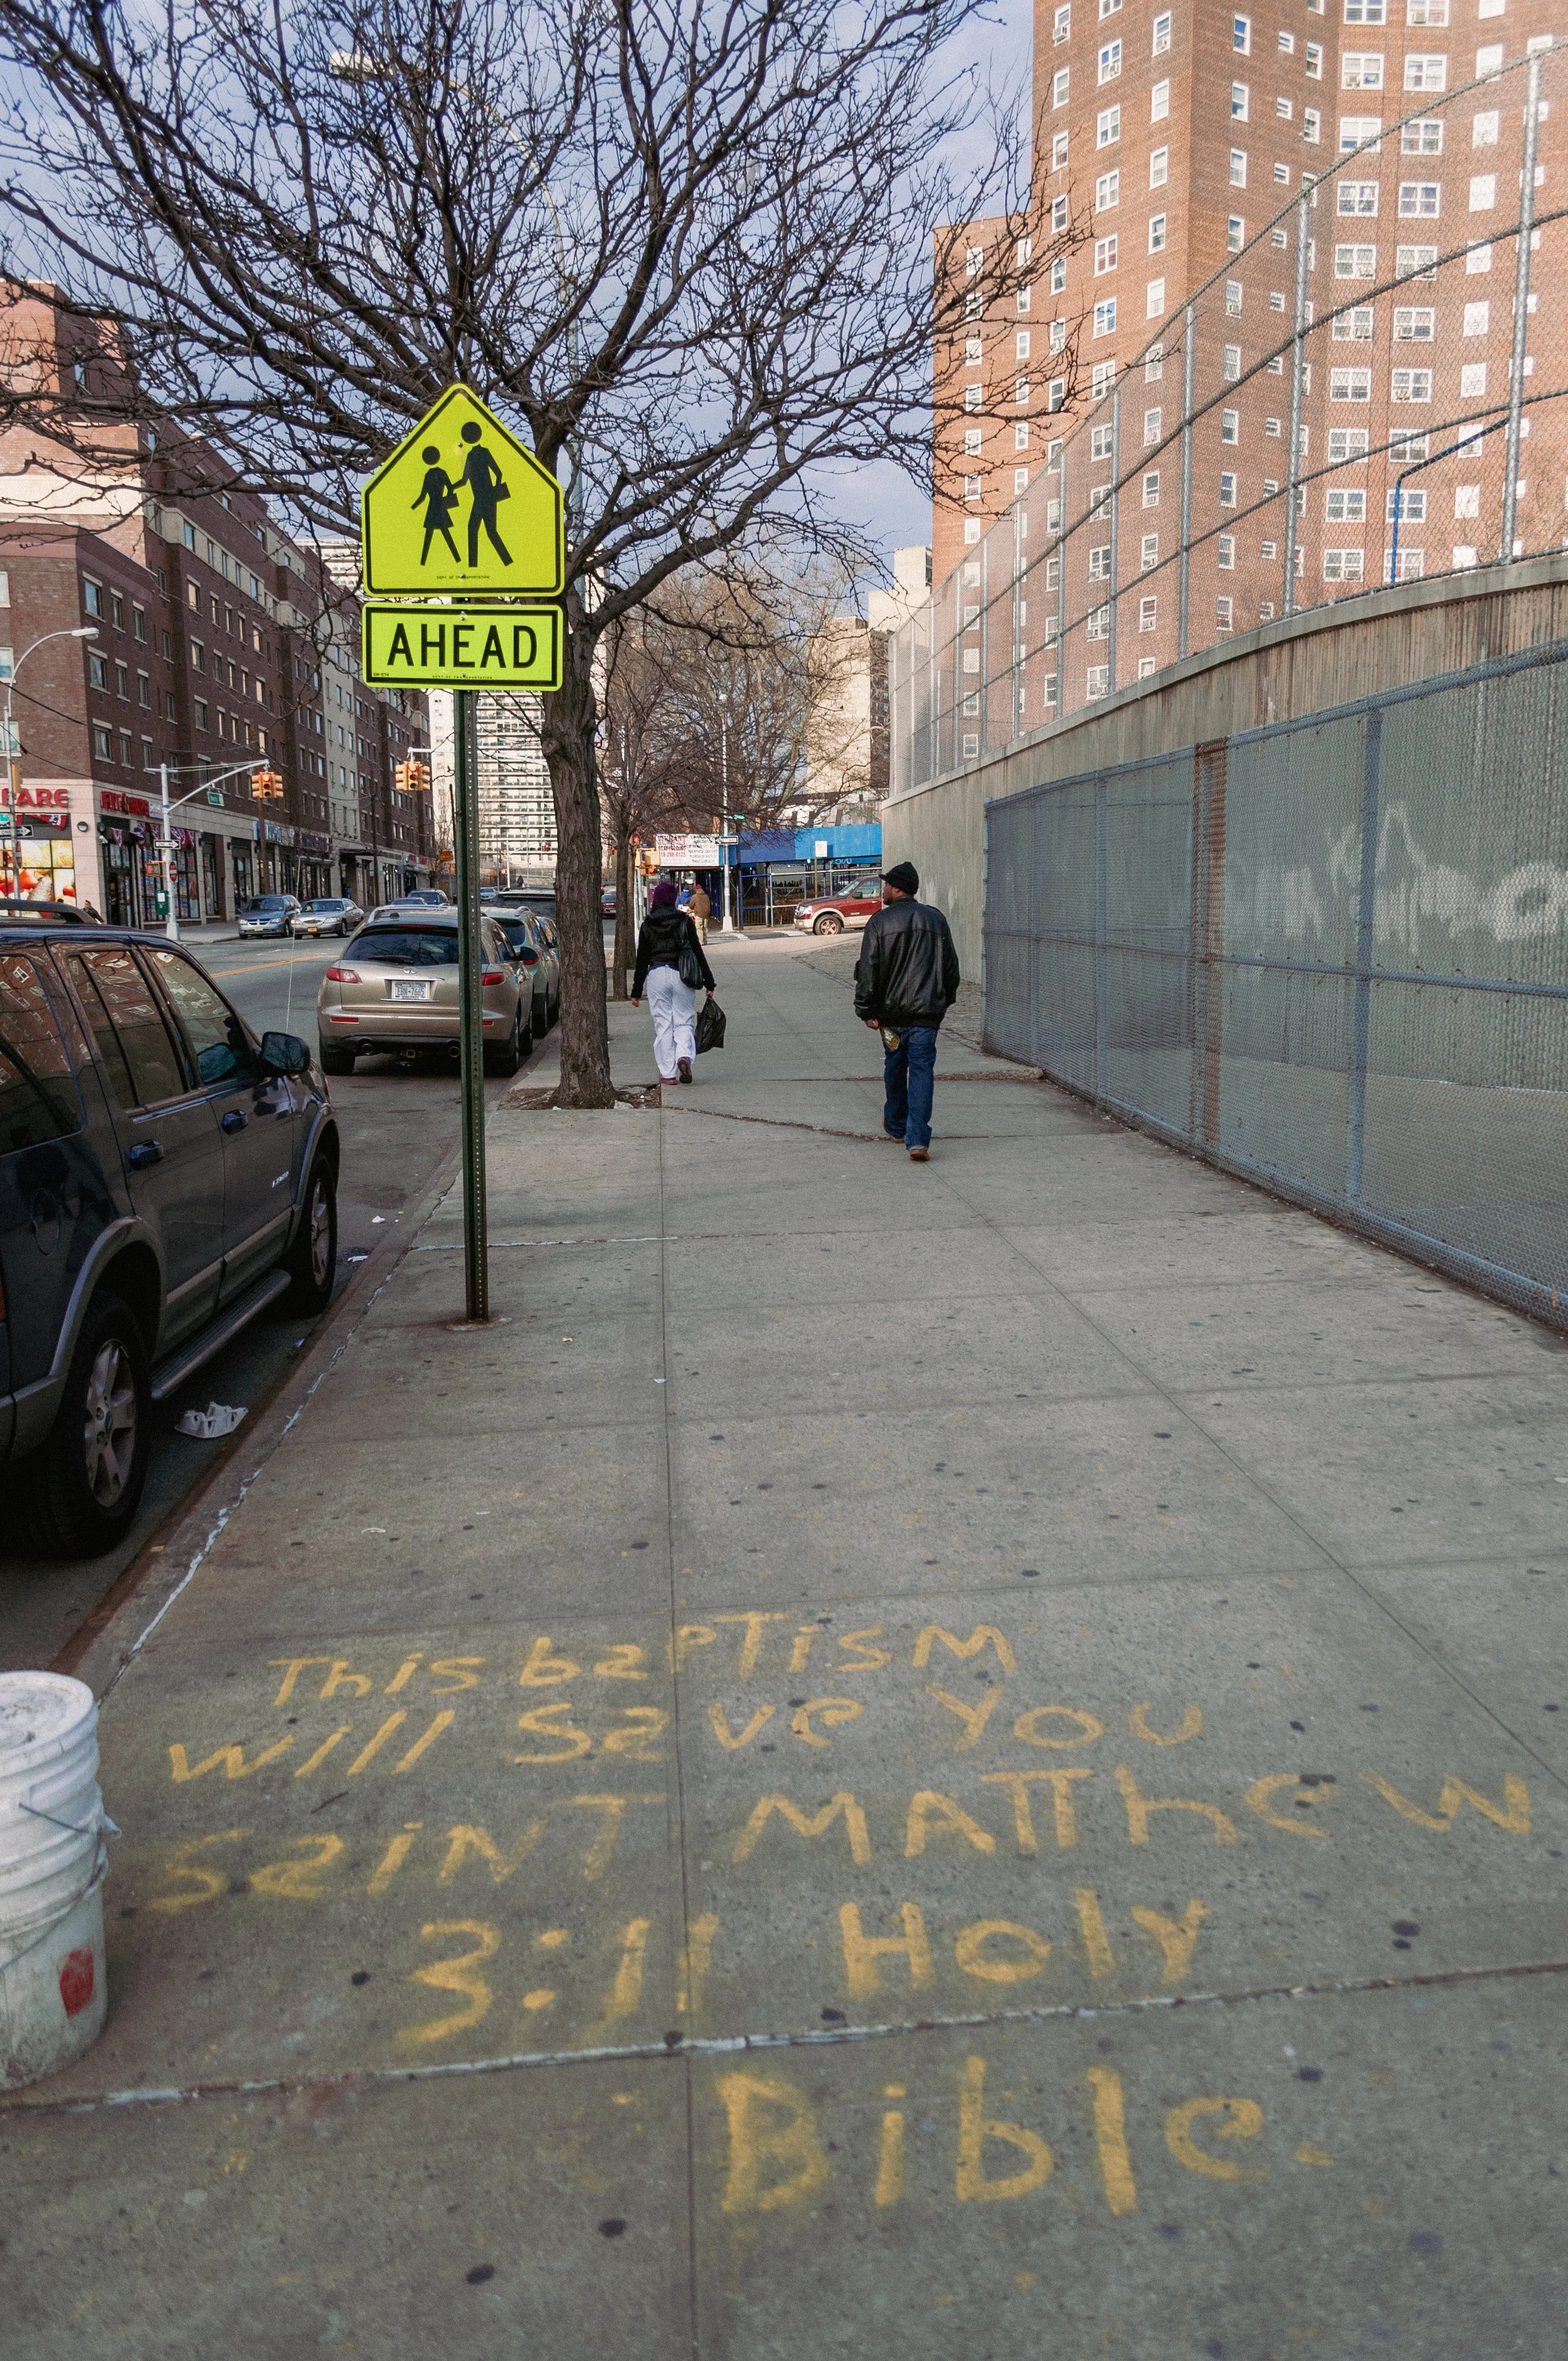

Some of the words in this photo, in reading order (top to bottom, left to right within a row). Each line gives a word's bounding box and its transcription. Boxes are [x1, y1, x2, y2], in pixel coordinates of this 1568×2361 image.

[387, 623, 538, 669] AHEAD
[270, 1653, 487, 1707] This
[166, 1709, 456, 1783] will
[395, 1916, 720, 2047] 3:11
